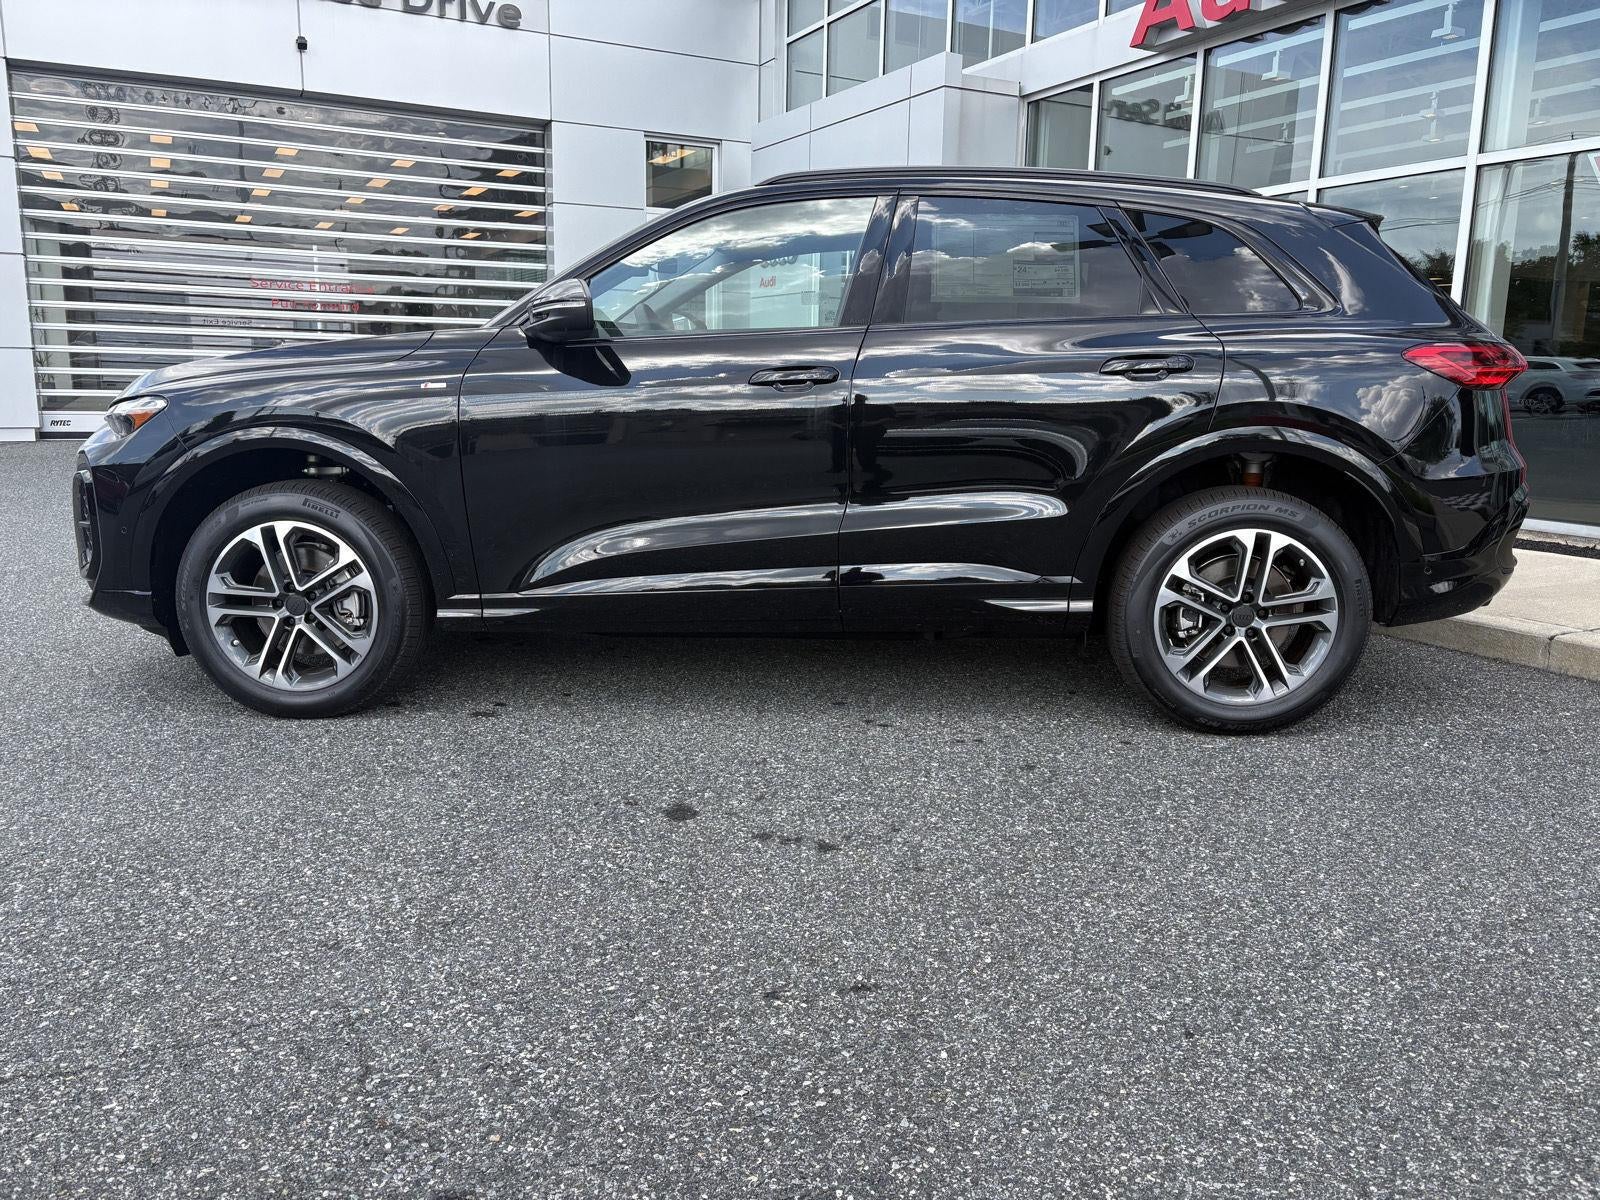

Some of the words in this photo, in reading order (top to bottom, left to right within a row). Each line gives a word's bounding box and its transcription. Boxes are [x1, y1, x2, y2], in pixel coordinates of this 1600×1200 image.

[250, 277, 304, 290] Service
[760, 276, 777, 288] Audi
[50, 419, 72, 427] RYTEC
[302, 497, 341, 519] PIRELLI
[1187, 503, 1271, 528] SCORPION
[1275, 506, 1300, 518] MS
